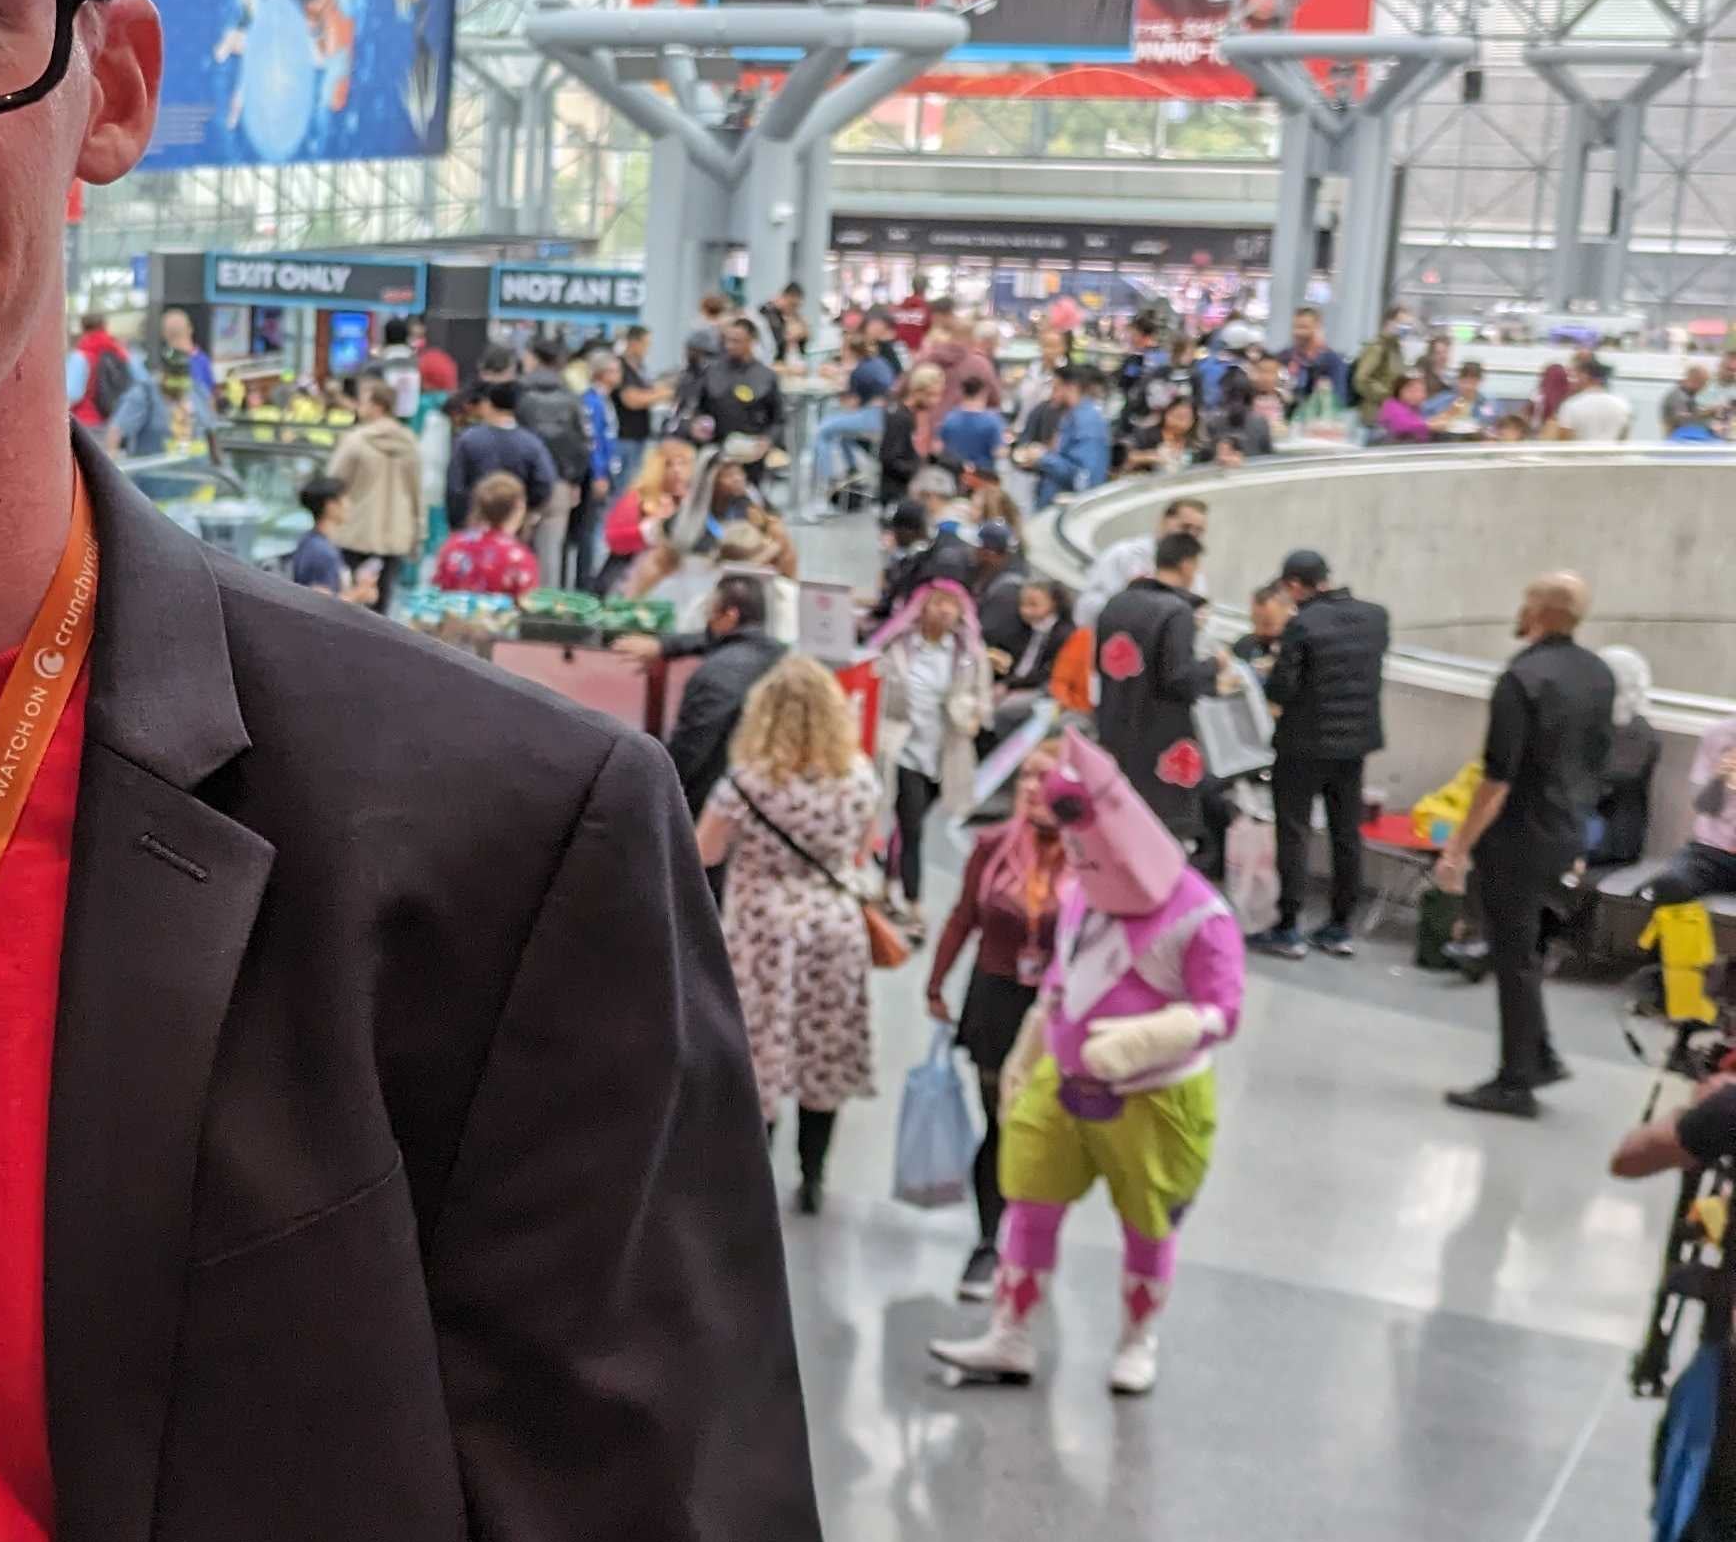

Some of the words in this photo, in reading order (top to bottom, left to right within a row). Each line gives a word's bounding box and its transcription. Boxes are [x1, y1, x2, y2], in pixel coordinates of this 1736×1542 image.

[217, 262, 276, 289] EXIT
[277, 264, 353, 293] ONLY
[501, 273, 566, 303] NOT
[565, 277, 611, 304] AN
[24, 686, 49, 718] ON
[55, 534, 99, 647] crunchyroll
